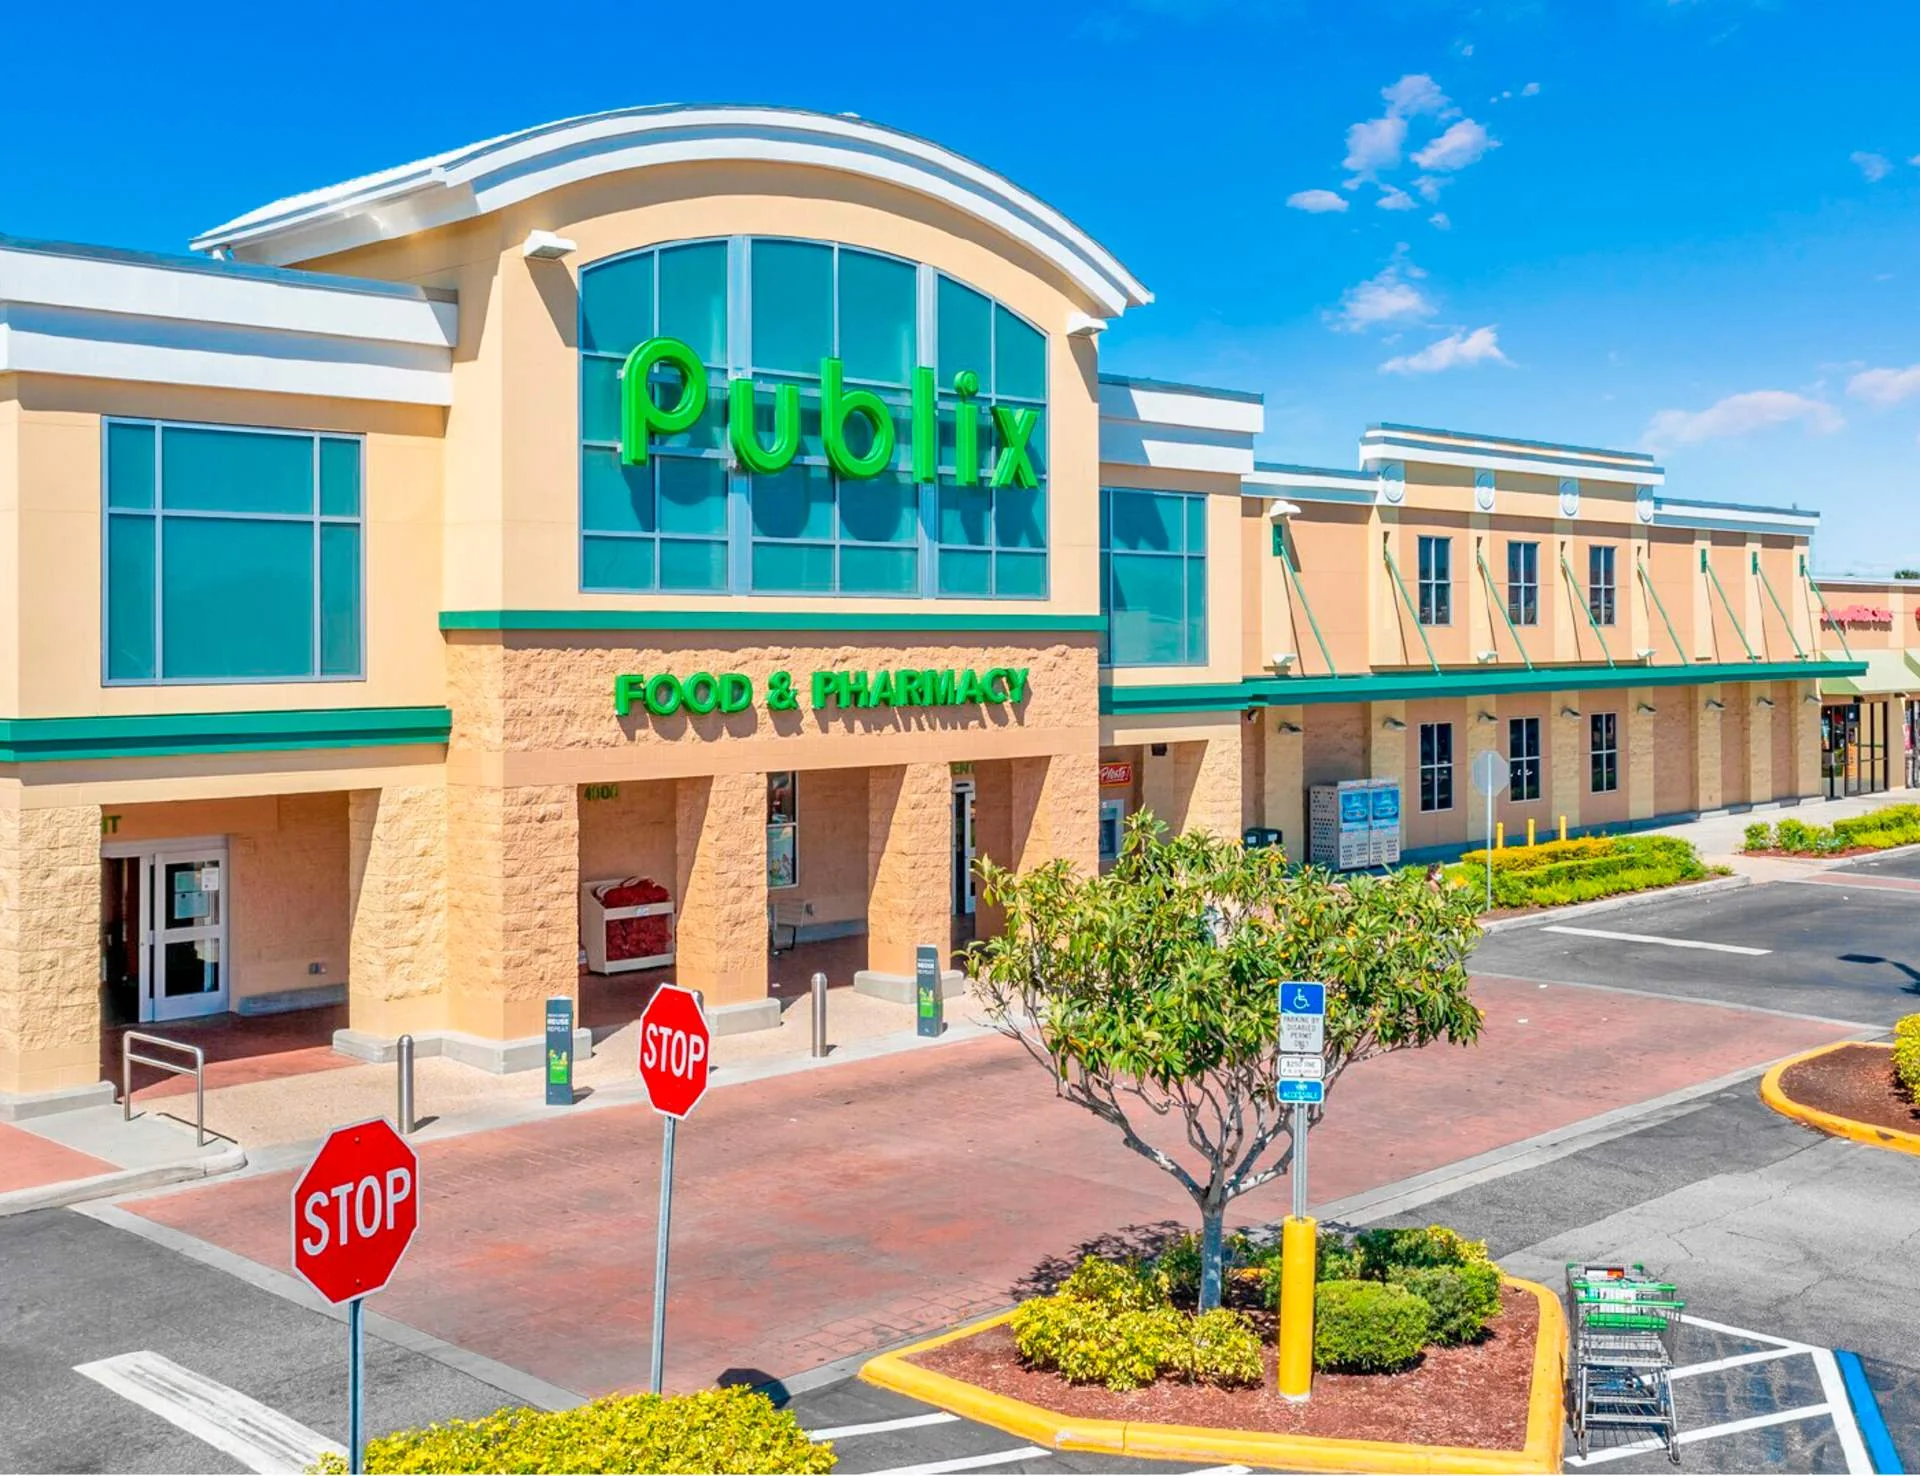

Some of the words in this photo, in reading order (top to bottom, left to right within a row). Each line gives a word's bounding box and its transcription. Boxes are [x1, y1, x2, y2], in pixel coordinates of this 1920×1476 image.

[622, 336, 1040, 489] Publix
[614, 671, 754, 717] FOOD
[766, 670, 799, 712] &
[811, 667, 1030, 710] PHARMACY
[643, 1023, 705, 1080] STOP
[302, 1167, 411, 1256] STOP
